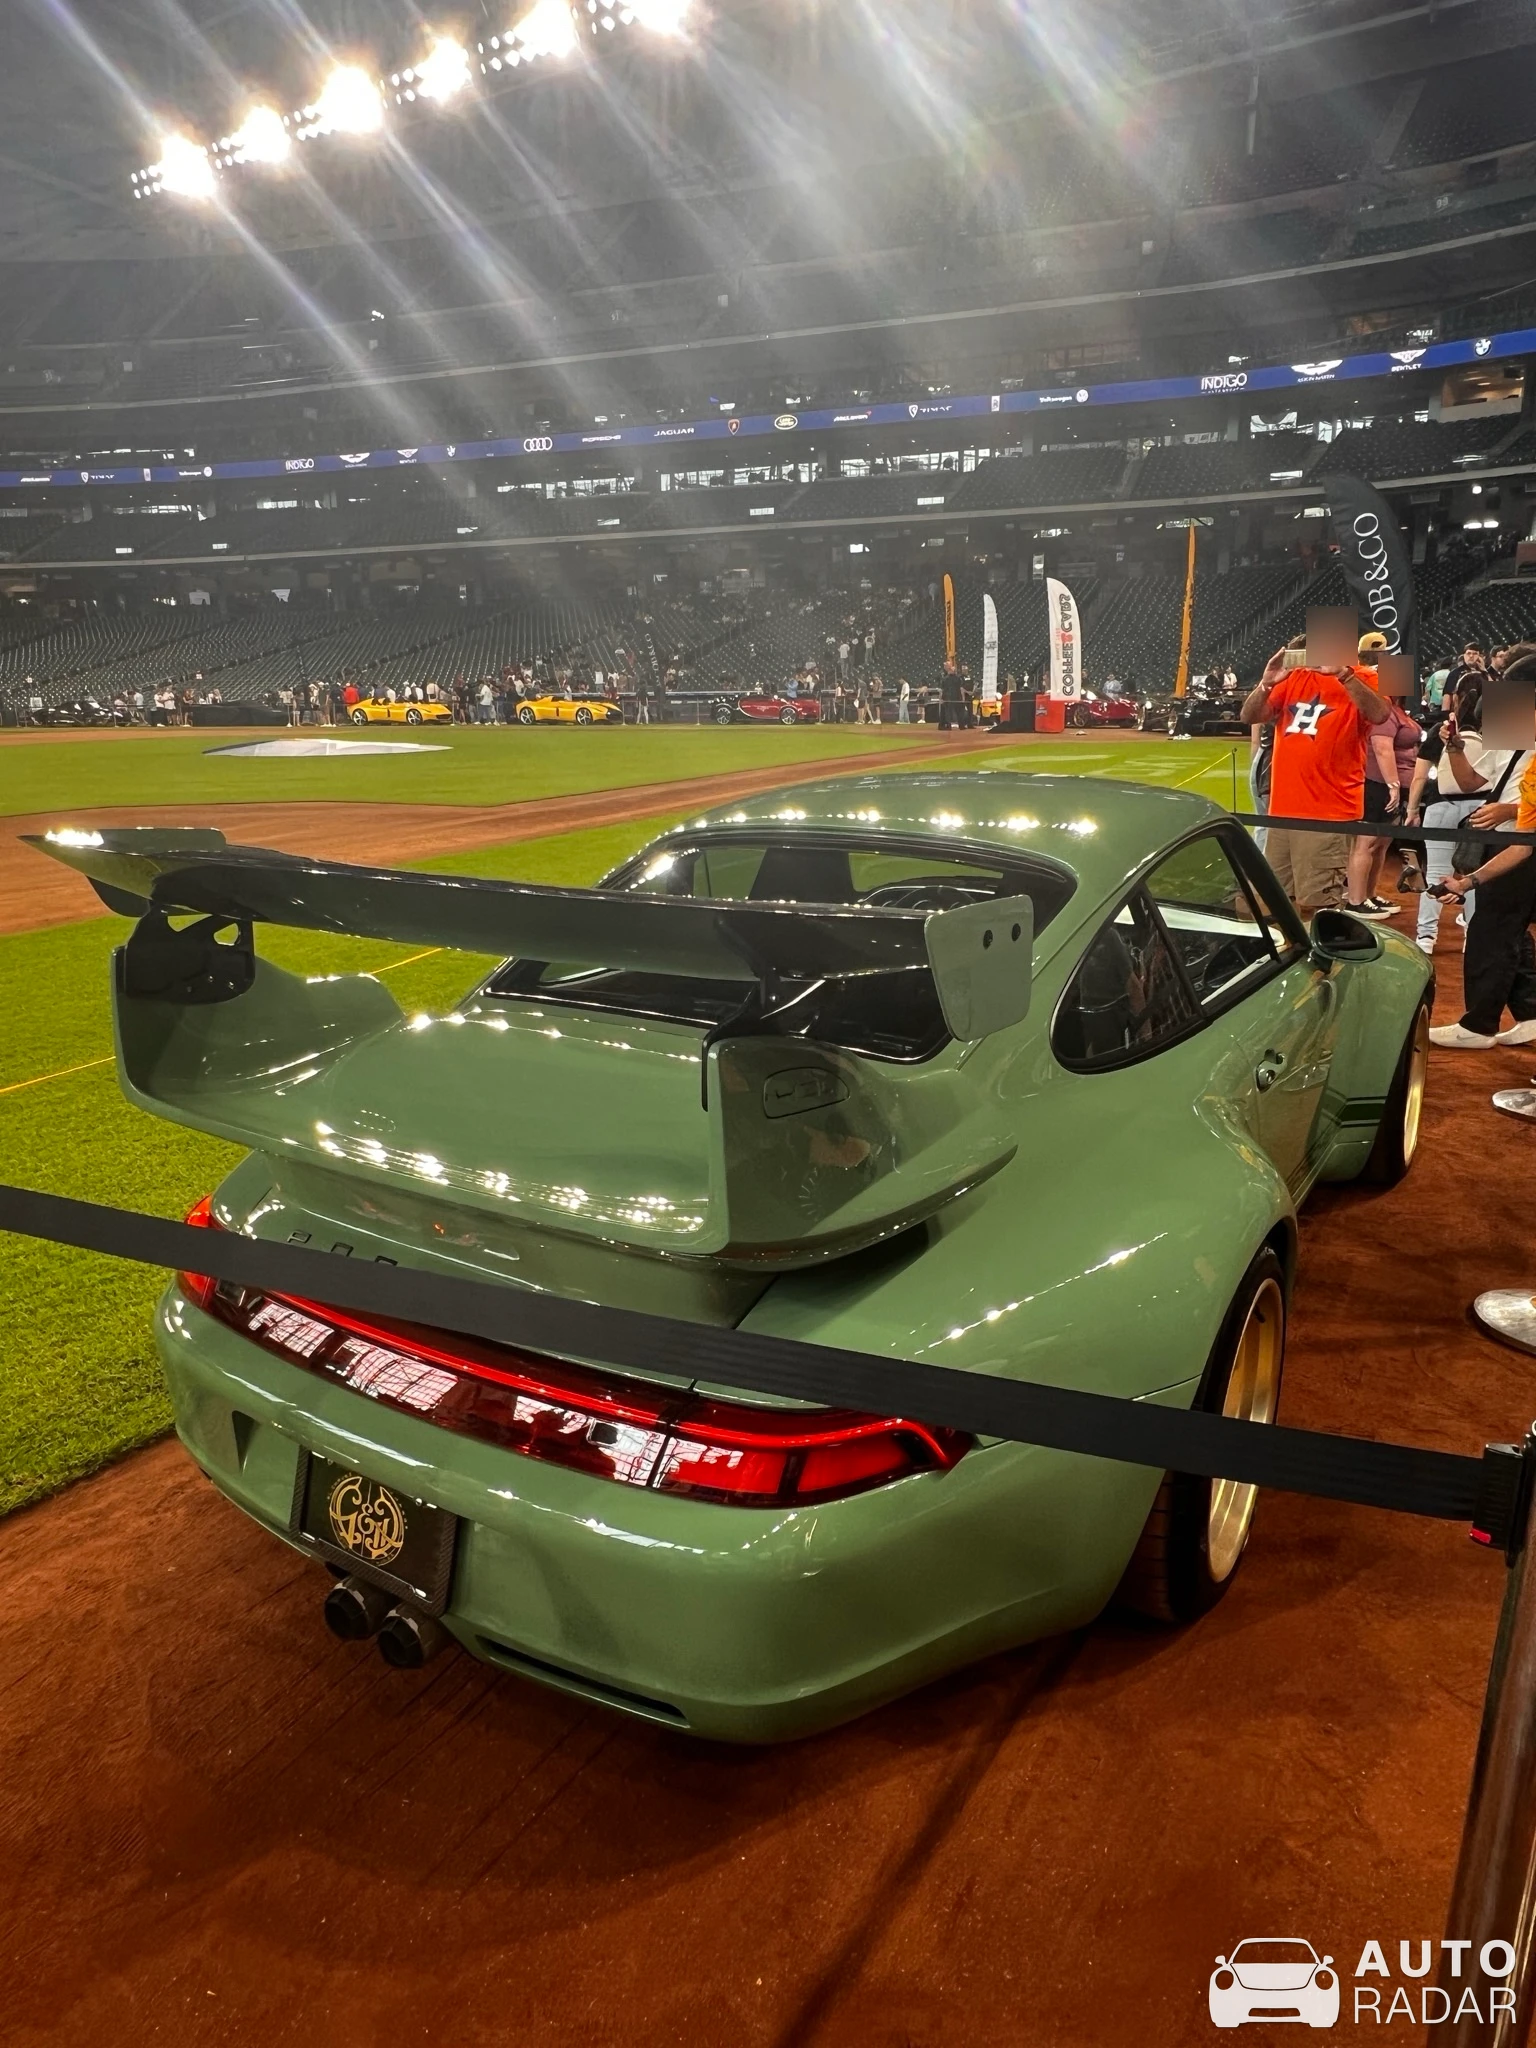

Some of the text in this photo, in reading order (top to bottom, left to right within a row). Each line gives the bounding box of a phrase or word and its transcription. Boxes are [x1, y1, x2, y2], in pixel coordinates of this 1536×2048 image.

[1200, 372, 1248, 391] INDIGO
[653, 427, 695, 437] JAGUAR
[285, 458, 315, 471] INDIGO
[1353, 512, 1402, 656] COB&CO
[1059, 593, 1073, 632] CARS
[1062, 643, 1074, 697] COFFEE
[1285, 701, 1327, 736] H
